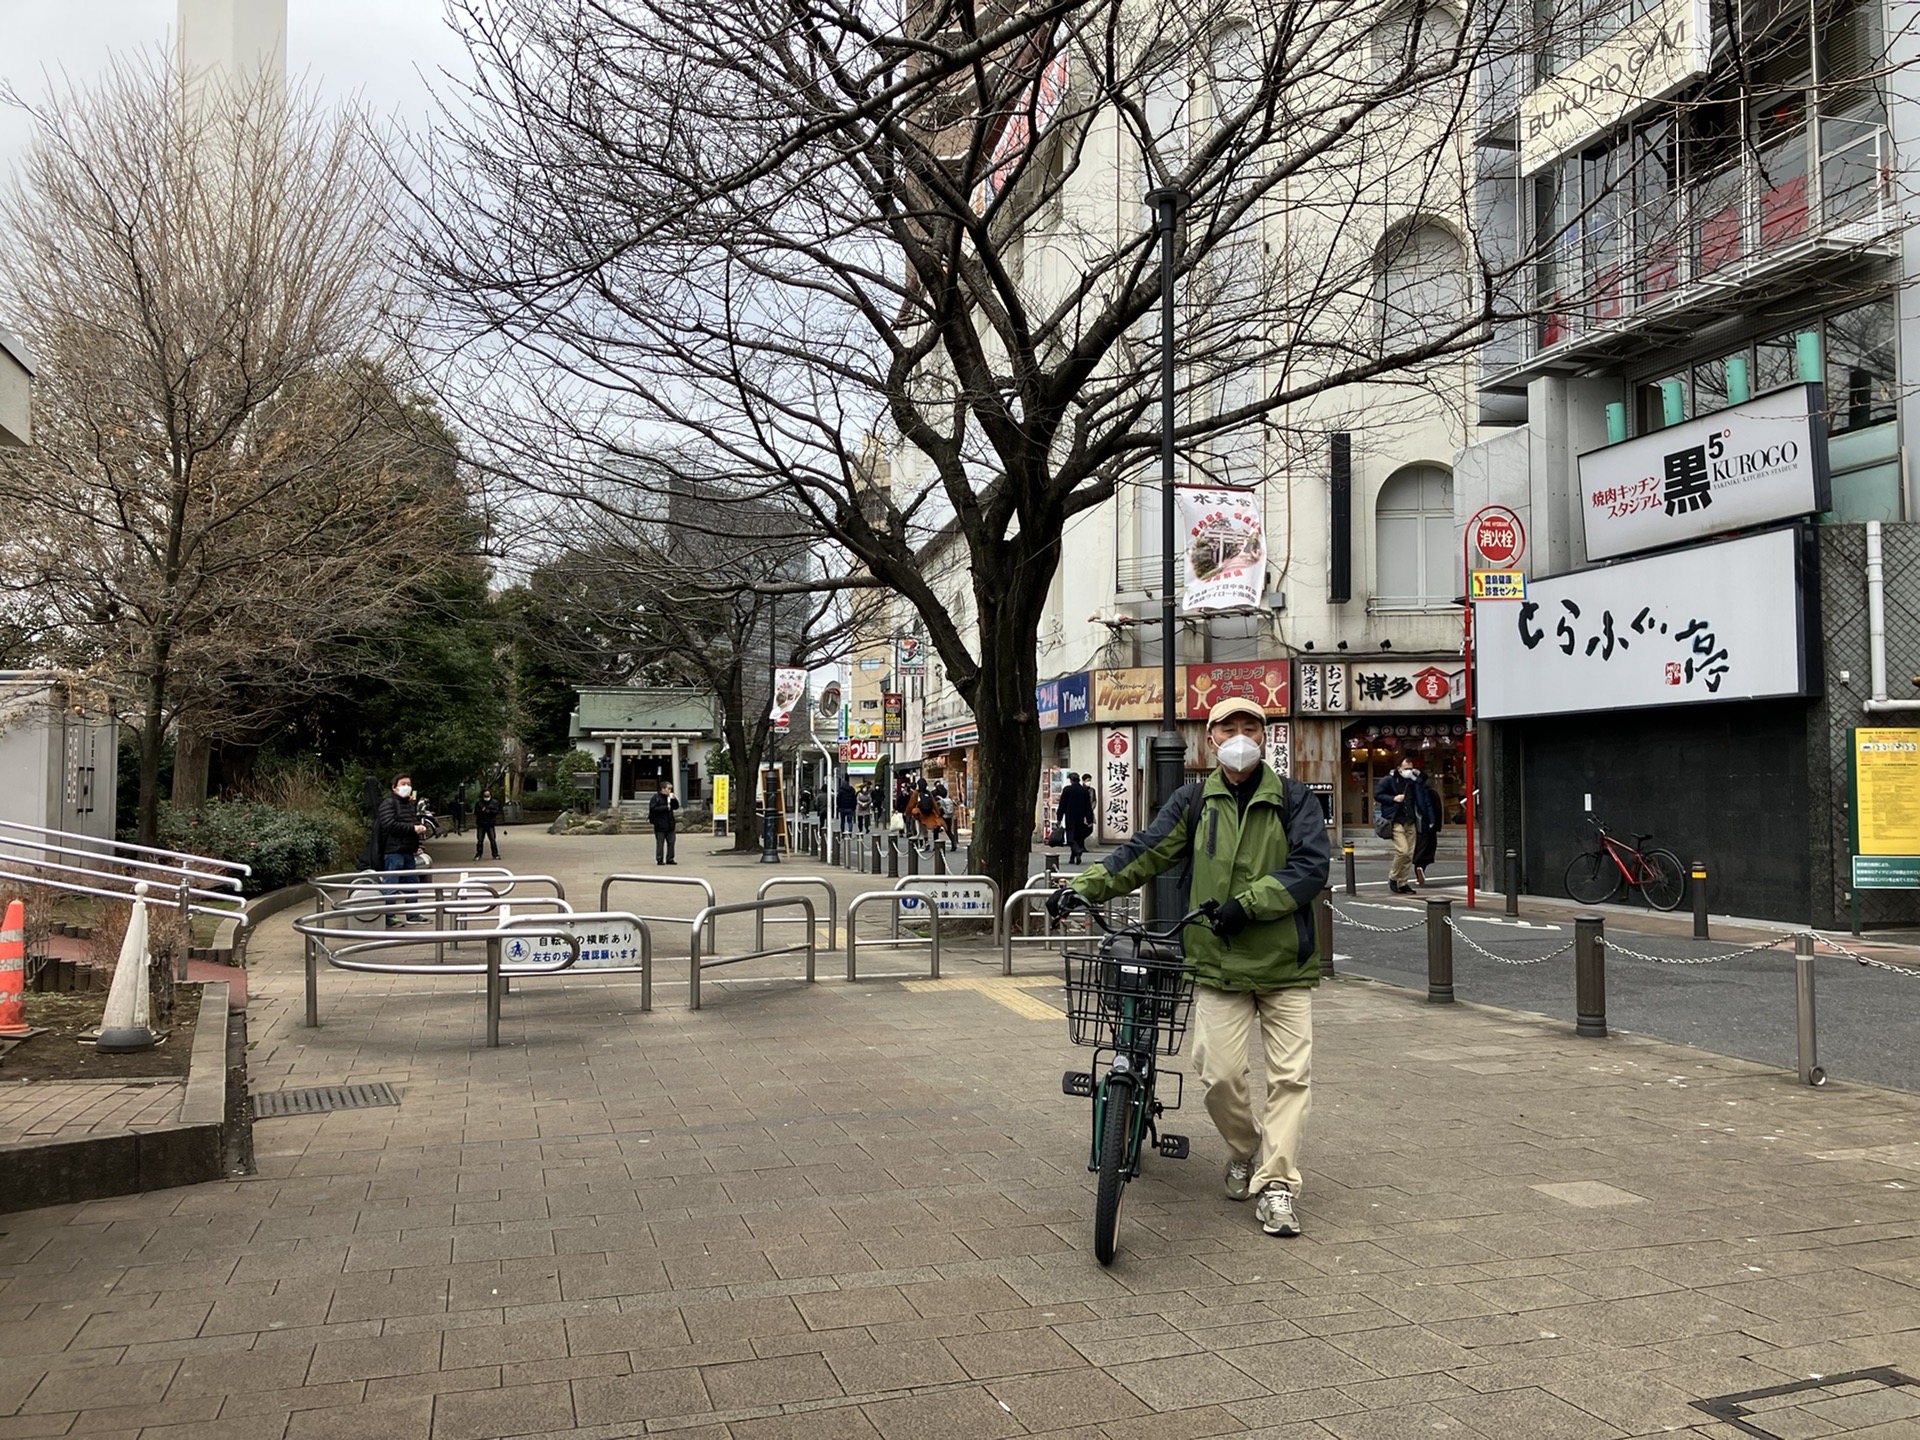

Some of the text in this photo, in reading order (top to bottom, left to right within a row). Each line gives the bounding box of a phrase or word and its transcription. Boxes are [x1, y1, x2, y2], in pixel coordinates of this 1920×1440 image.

[1528, 63, 1622, 140] BUKURO
[1712, 440, 1799, 483] KUROGO
[1663, 444, 1713, 518] 黒
[1713, 462, 1799, 491] YAKINIKU KITCHEN STADIUM
[1591, 476, 1661, 508] 焼肉キッチン
[1606, 493, 1663, 520] スタジアム
[1480, 529, 1514, 548] 消火栓
[1210, 665, 1265, 681] ボウリング
[1221, 681, 1255, 694] ゲーム
[1301, 665, 1319, 710] 博多串焼
[1327, 665, 1343, 709] おでん
[1354, 672, 1414, 702] 博多
[1097, 682, 1186, 711] Hyper Lae
[850, 741, 878, 760] つり具
[1106, 761, 1130, 834] 博多劇場
[930, 890, 981, 899] 公園内通路
[532, 948, 638, 962] 左右の安確認願います
